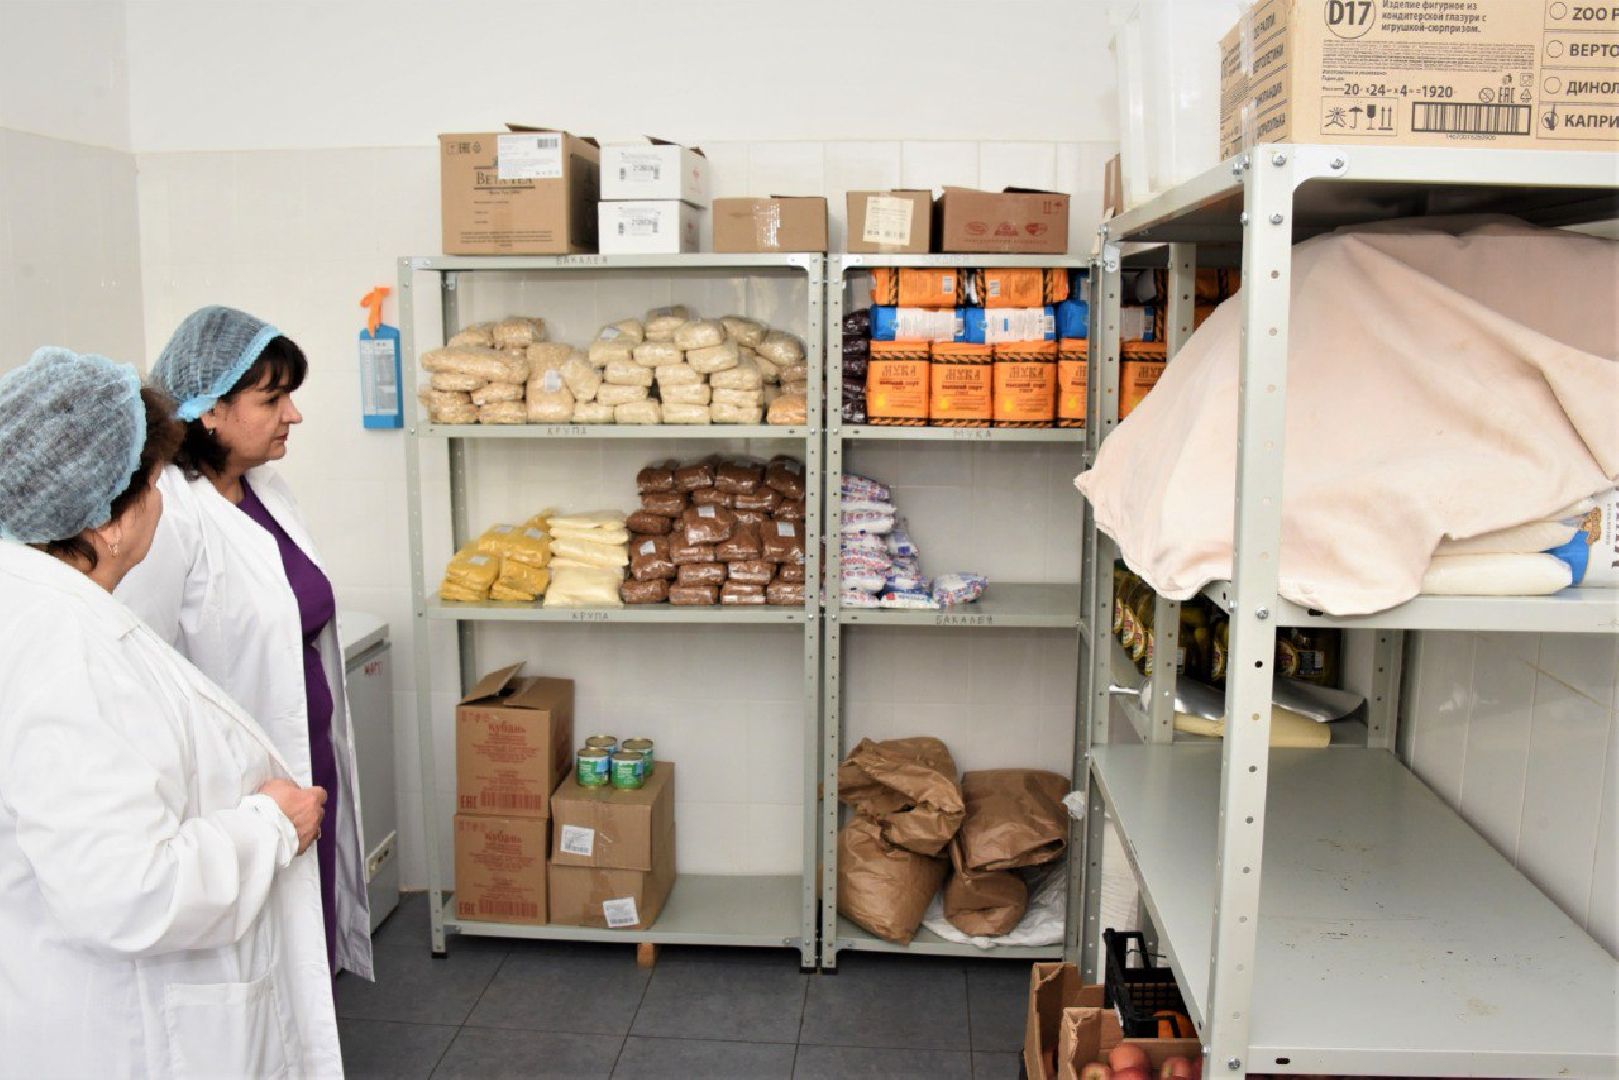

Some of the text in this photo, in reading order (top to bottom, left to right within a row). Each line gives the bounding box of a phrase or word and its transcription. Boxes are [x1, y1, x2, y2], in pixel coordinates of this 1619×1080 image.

[1422, 1, 1464, 11] фигурное
[1467, 2, 1477, 10] из
[1328, 0, 1372, 25] D17
[1382, 12, 1443, 22] кондитерской
[1445, 14, 1480, 24] глазури
[1381, 24, 1482, 34] игрушкой-сюрпризом.
[1569, 44, 1619, 57] ВЕРТО
